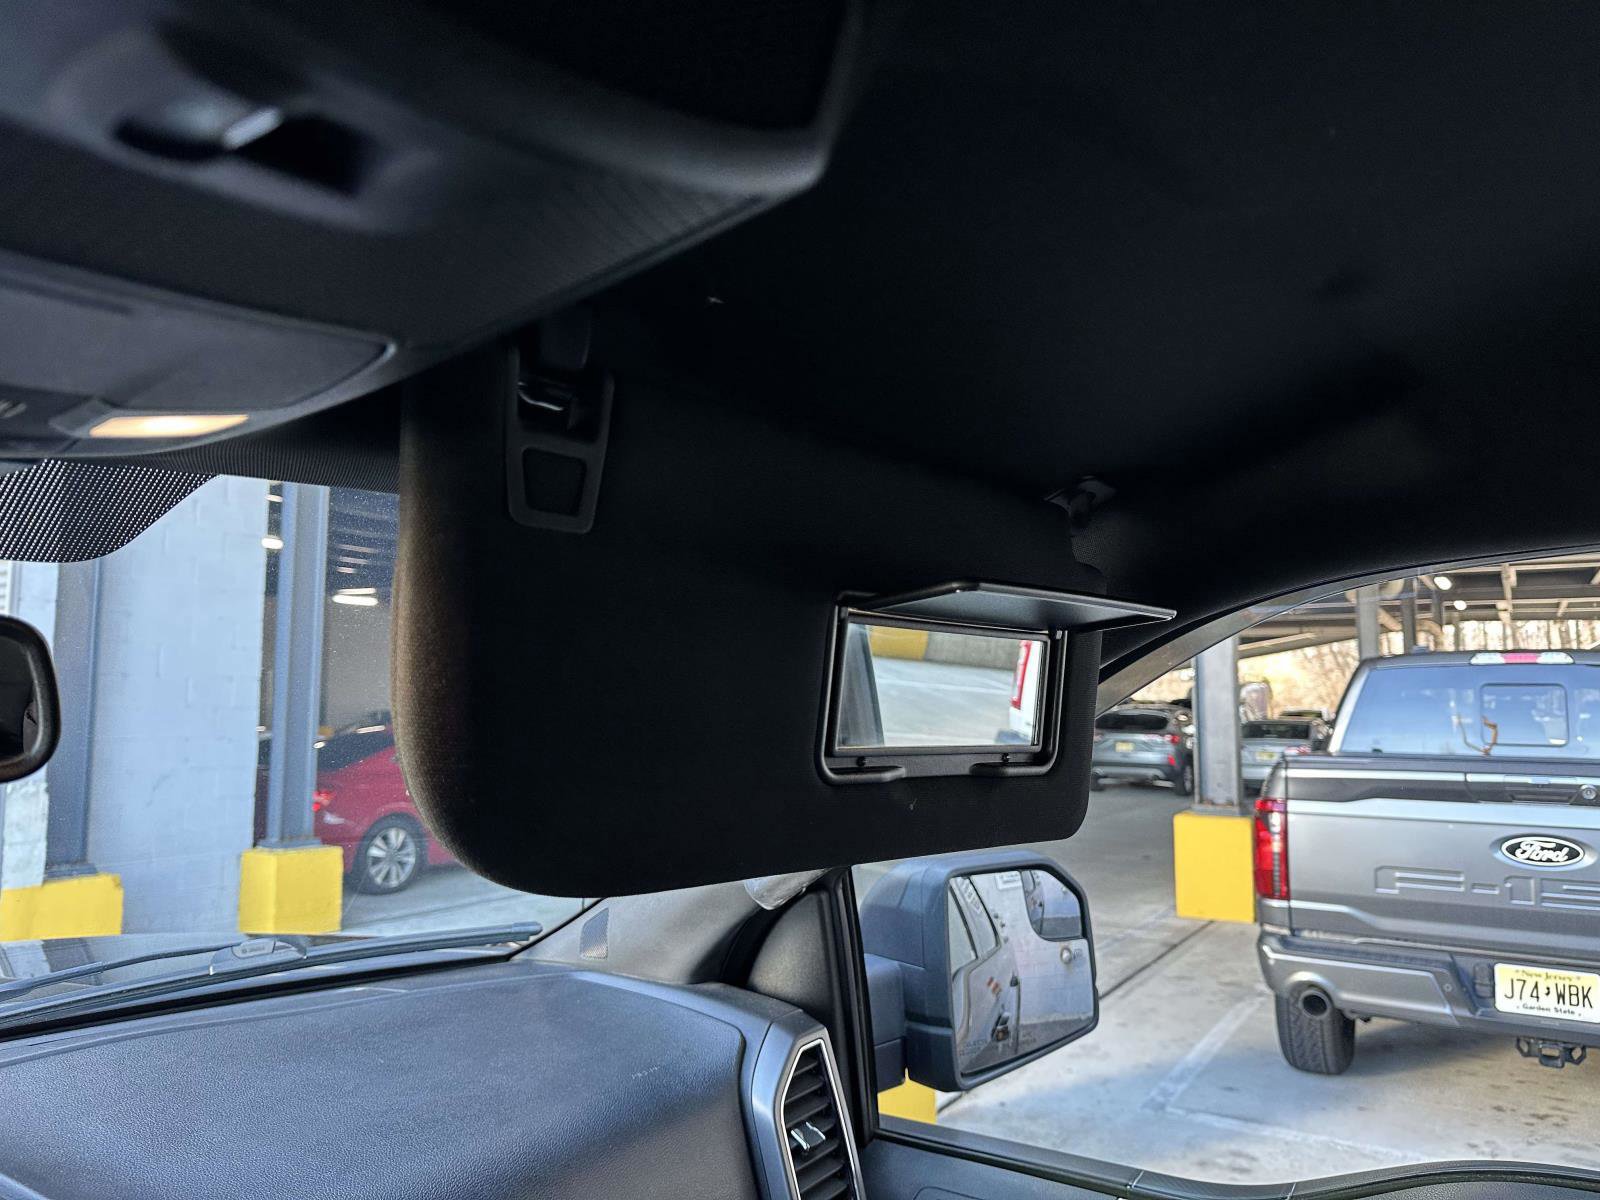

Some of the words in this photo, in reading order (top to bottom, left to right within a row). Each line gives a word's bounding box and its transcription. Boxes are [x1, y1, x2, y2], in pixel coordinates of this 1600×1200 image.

[1515, 839, 1570, 863] Ford
[1522, 1003, 1551, 1013] Garden
[1554, 1006, 1576, 1016] State
